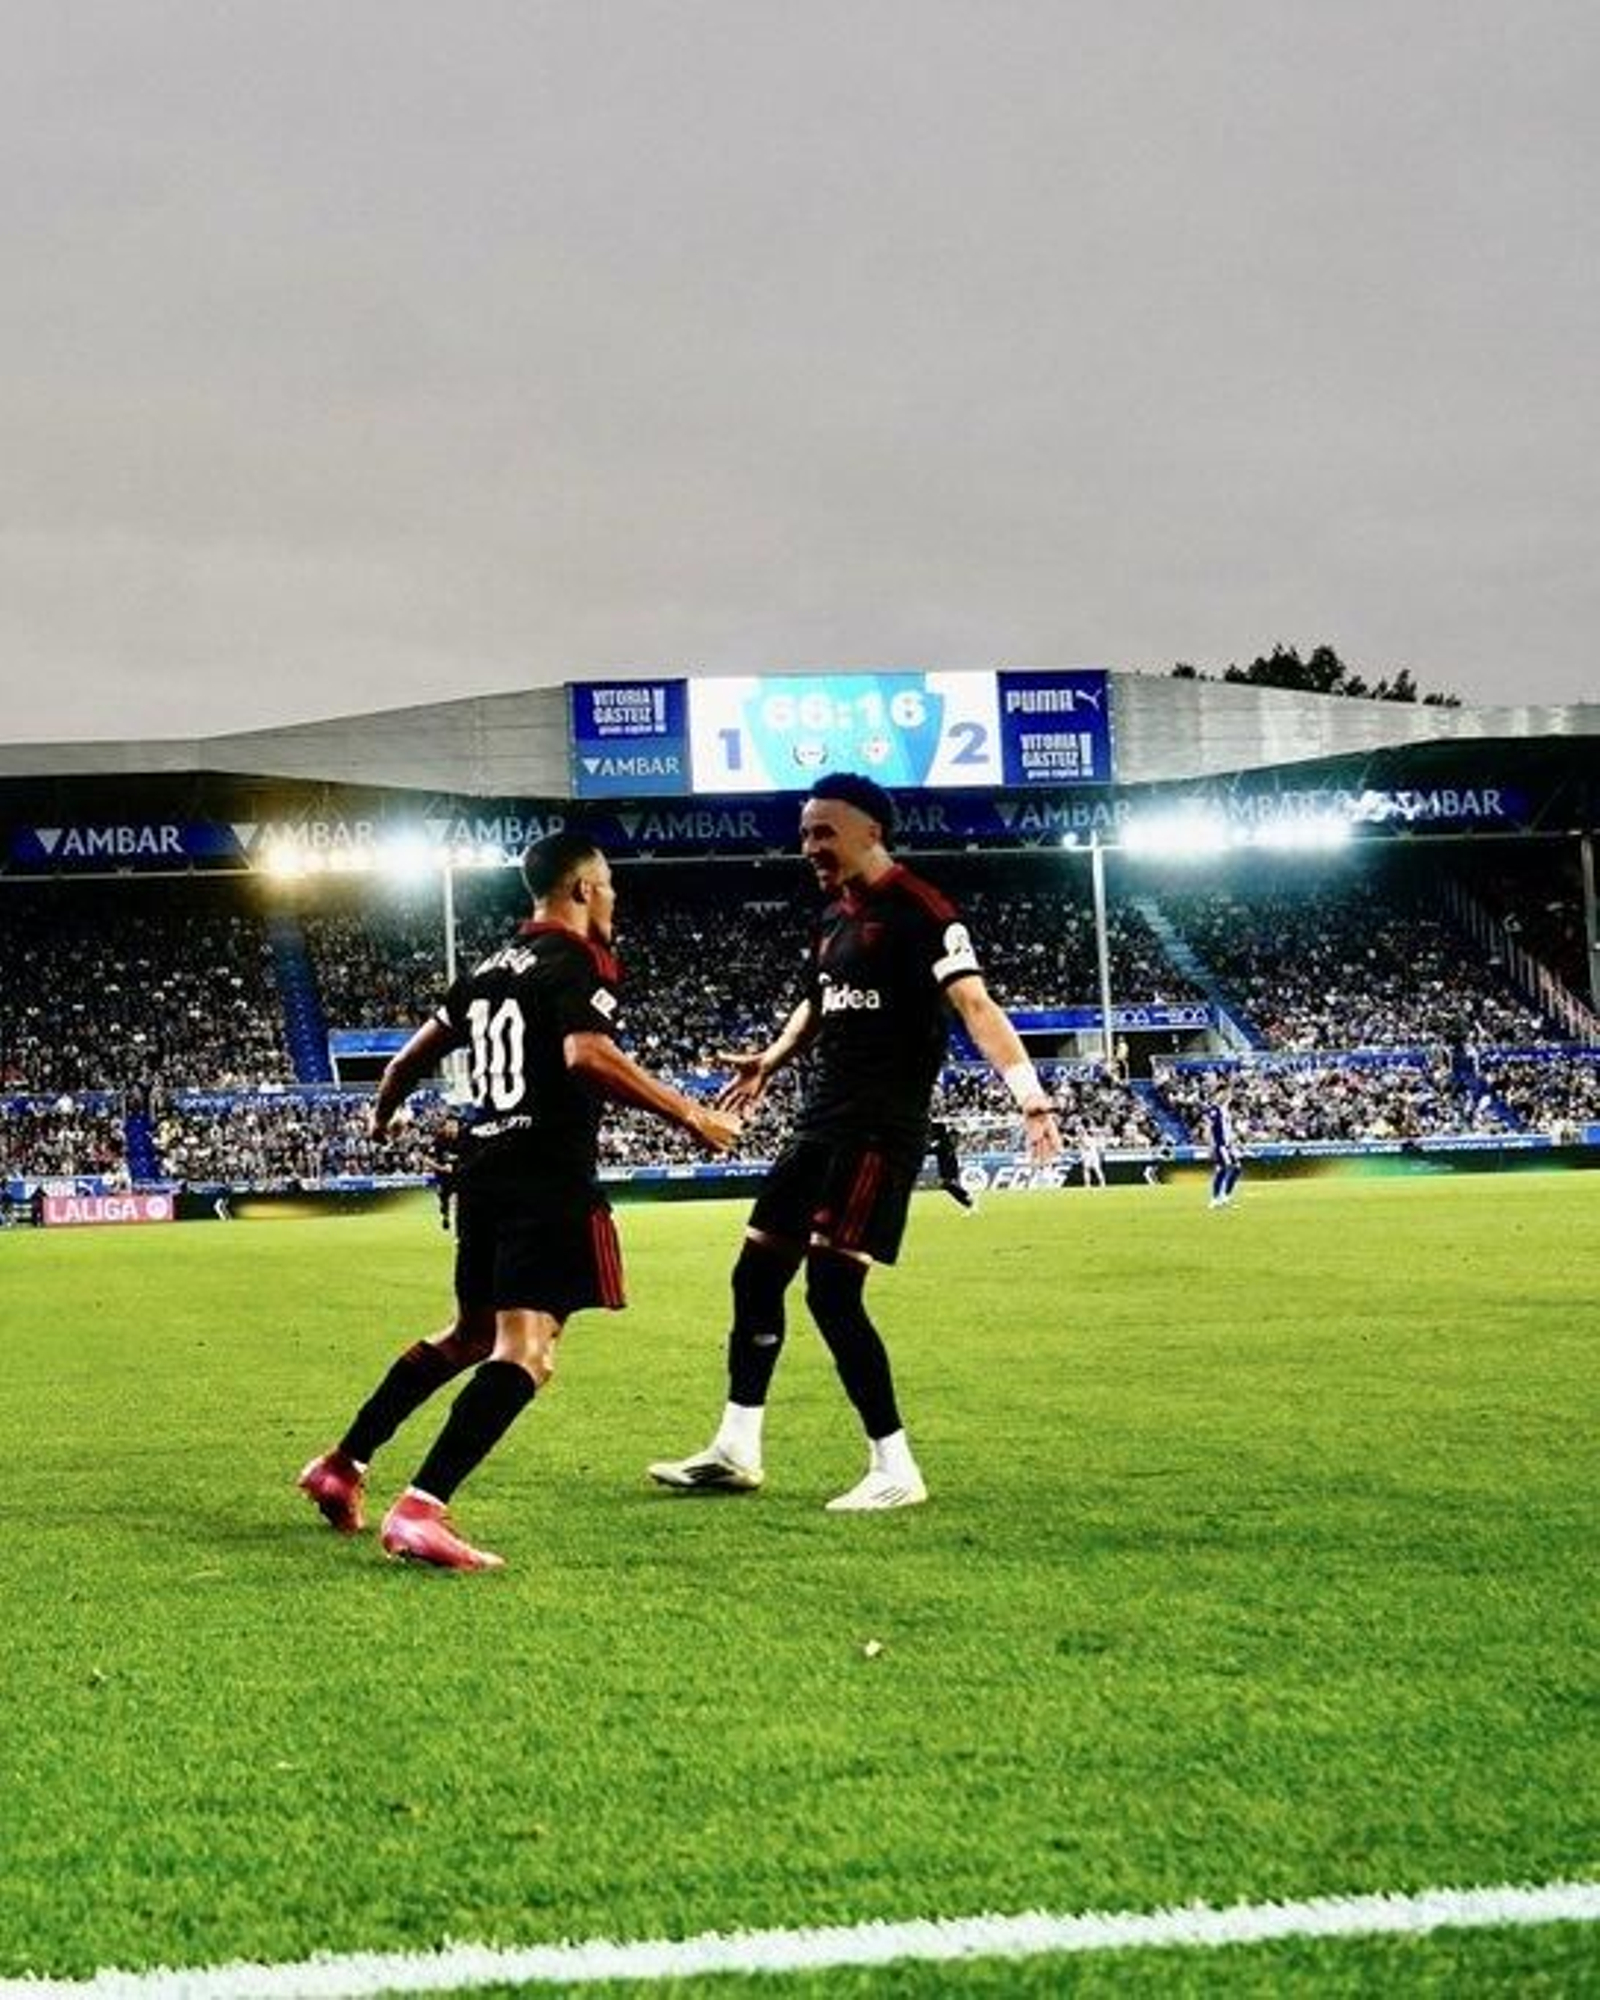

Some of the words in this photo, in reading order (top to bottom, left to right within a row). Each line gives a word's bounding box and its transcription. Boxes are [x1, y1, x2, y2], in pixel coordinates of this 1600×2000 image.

[1006, 690, 1074, 713] PUMA
[719, 728, 742, 770] 1
[949, 722, 989, 764] 2
[601, 757, 680, 777] AMBAR
[643, 811, 763, 841] AMBAR
[1020, 801, 1131, 829] AMBAR
[63, 824, 184, 856] AMBAR
[258, 820, 377, 850] AMBAR
[467, 998, 526, 1112] 10
[49, 1198, 138, 1223] LALIGA
